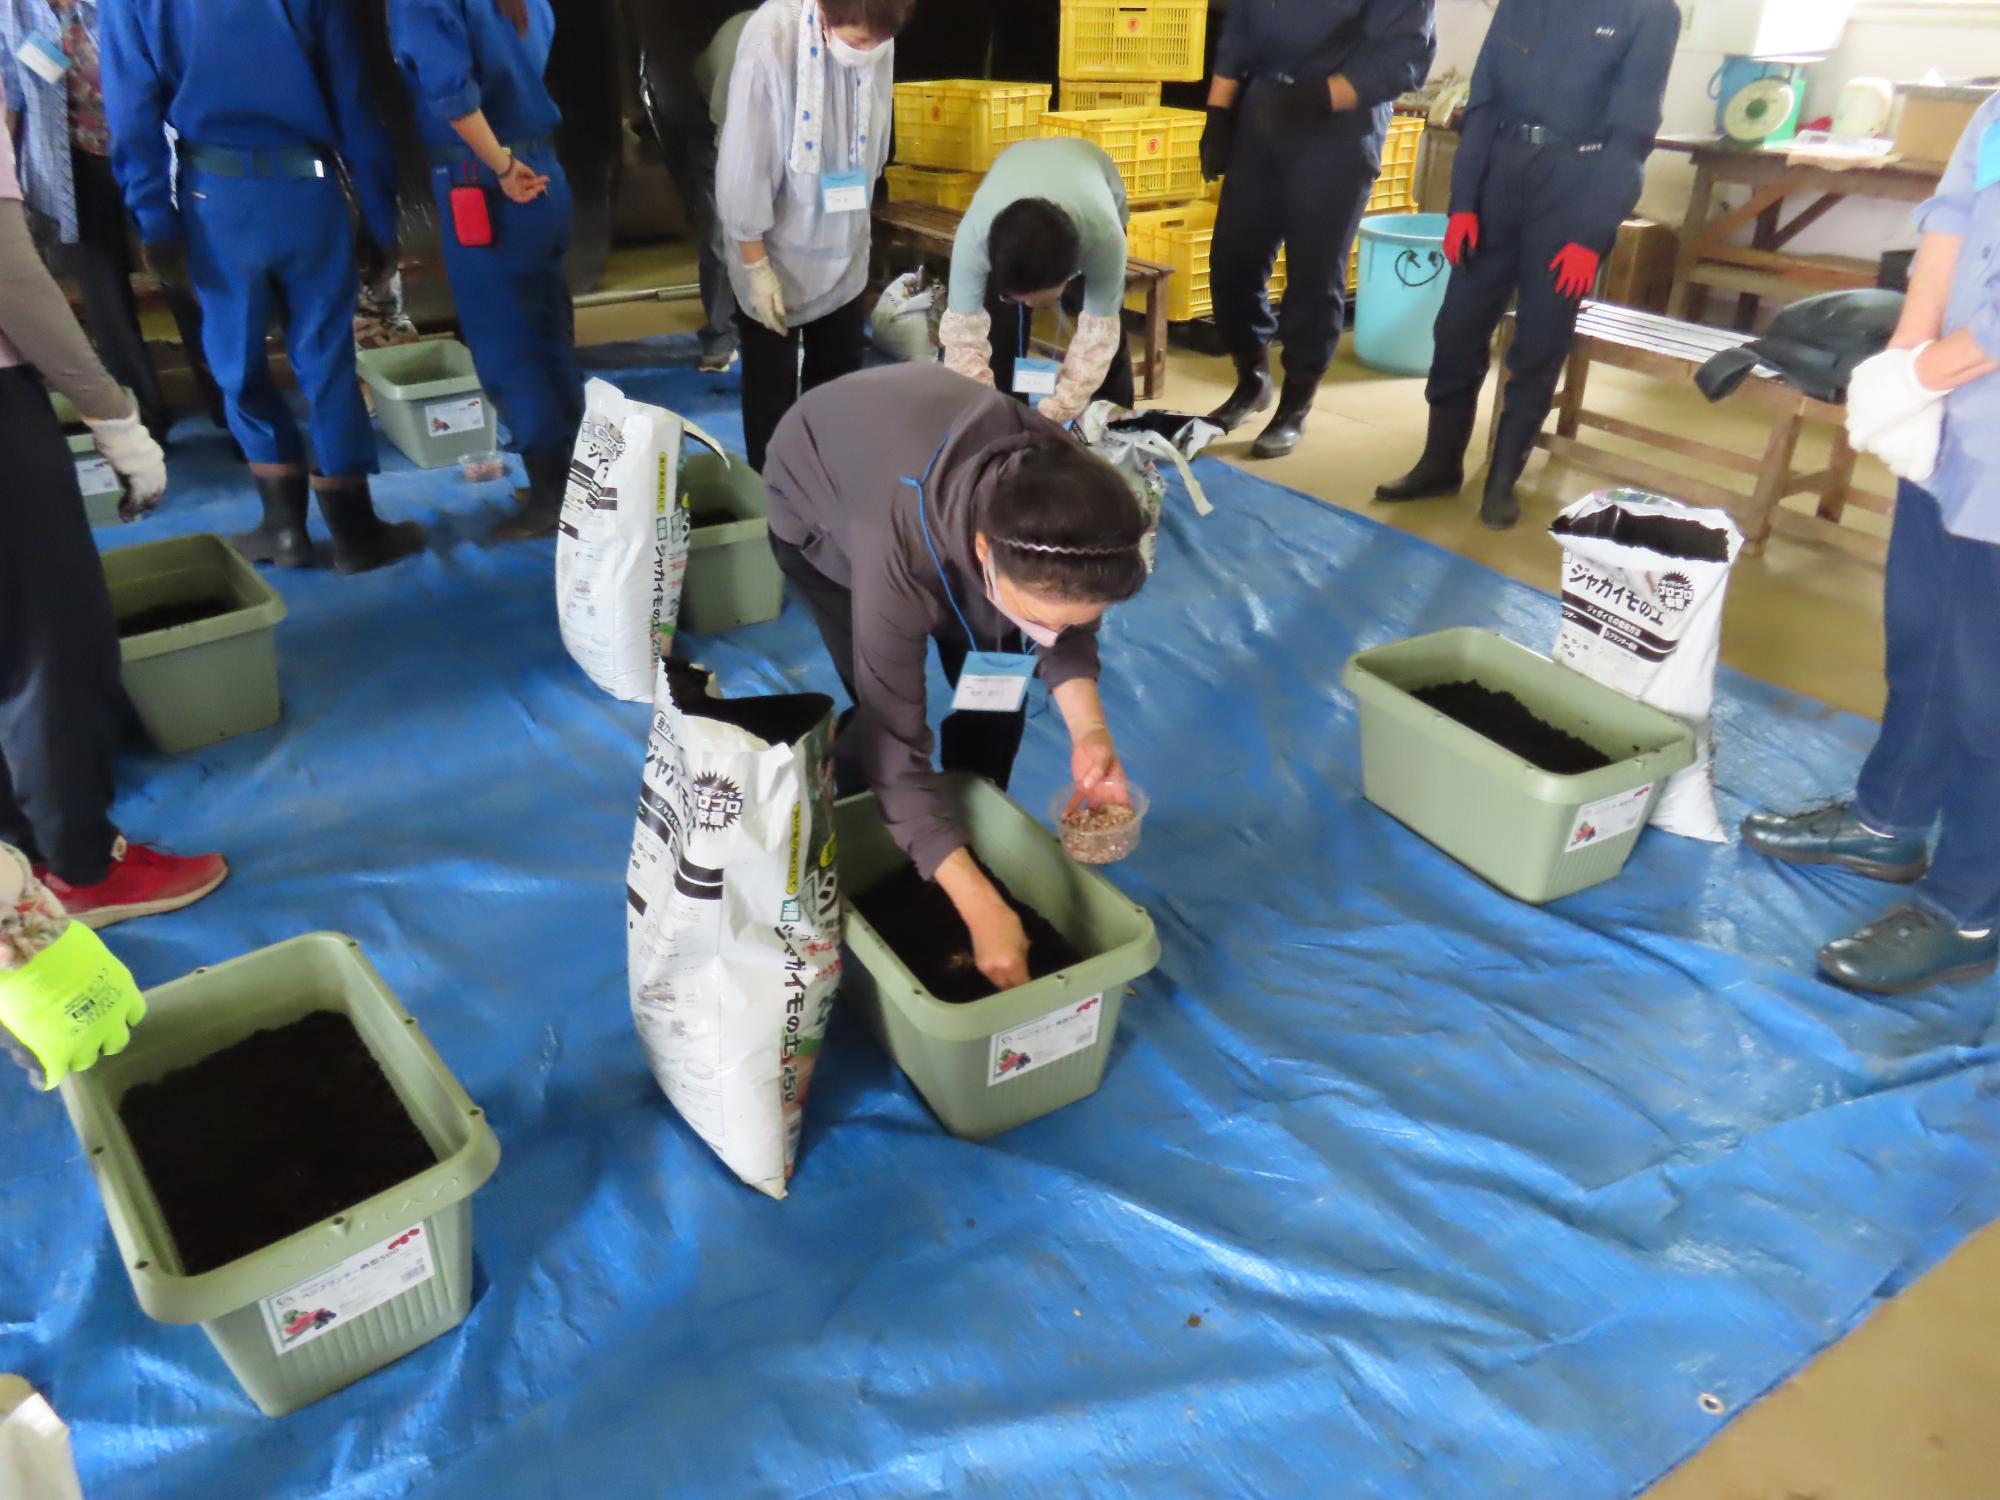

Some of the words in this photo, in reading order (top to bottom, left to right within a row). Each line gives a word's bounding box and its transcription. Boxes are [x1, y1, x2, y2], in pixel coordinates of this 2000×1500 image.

[774, 924, 808, 1058] ジャガイモの土
